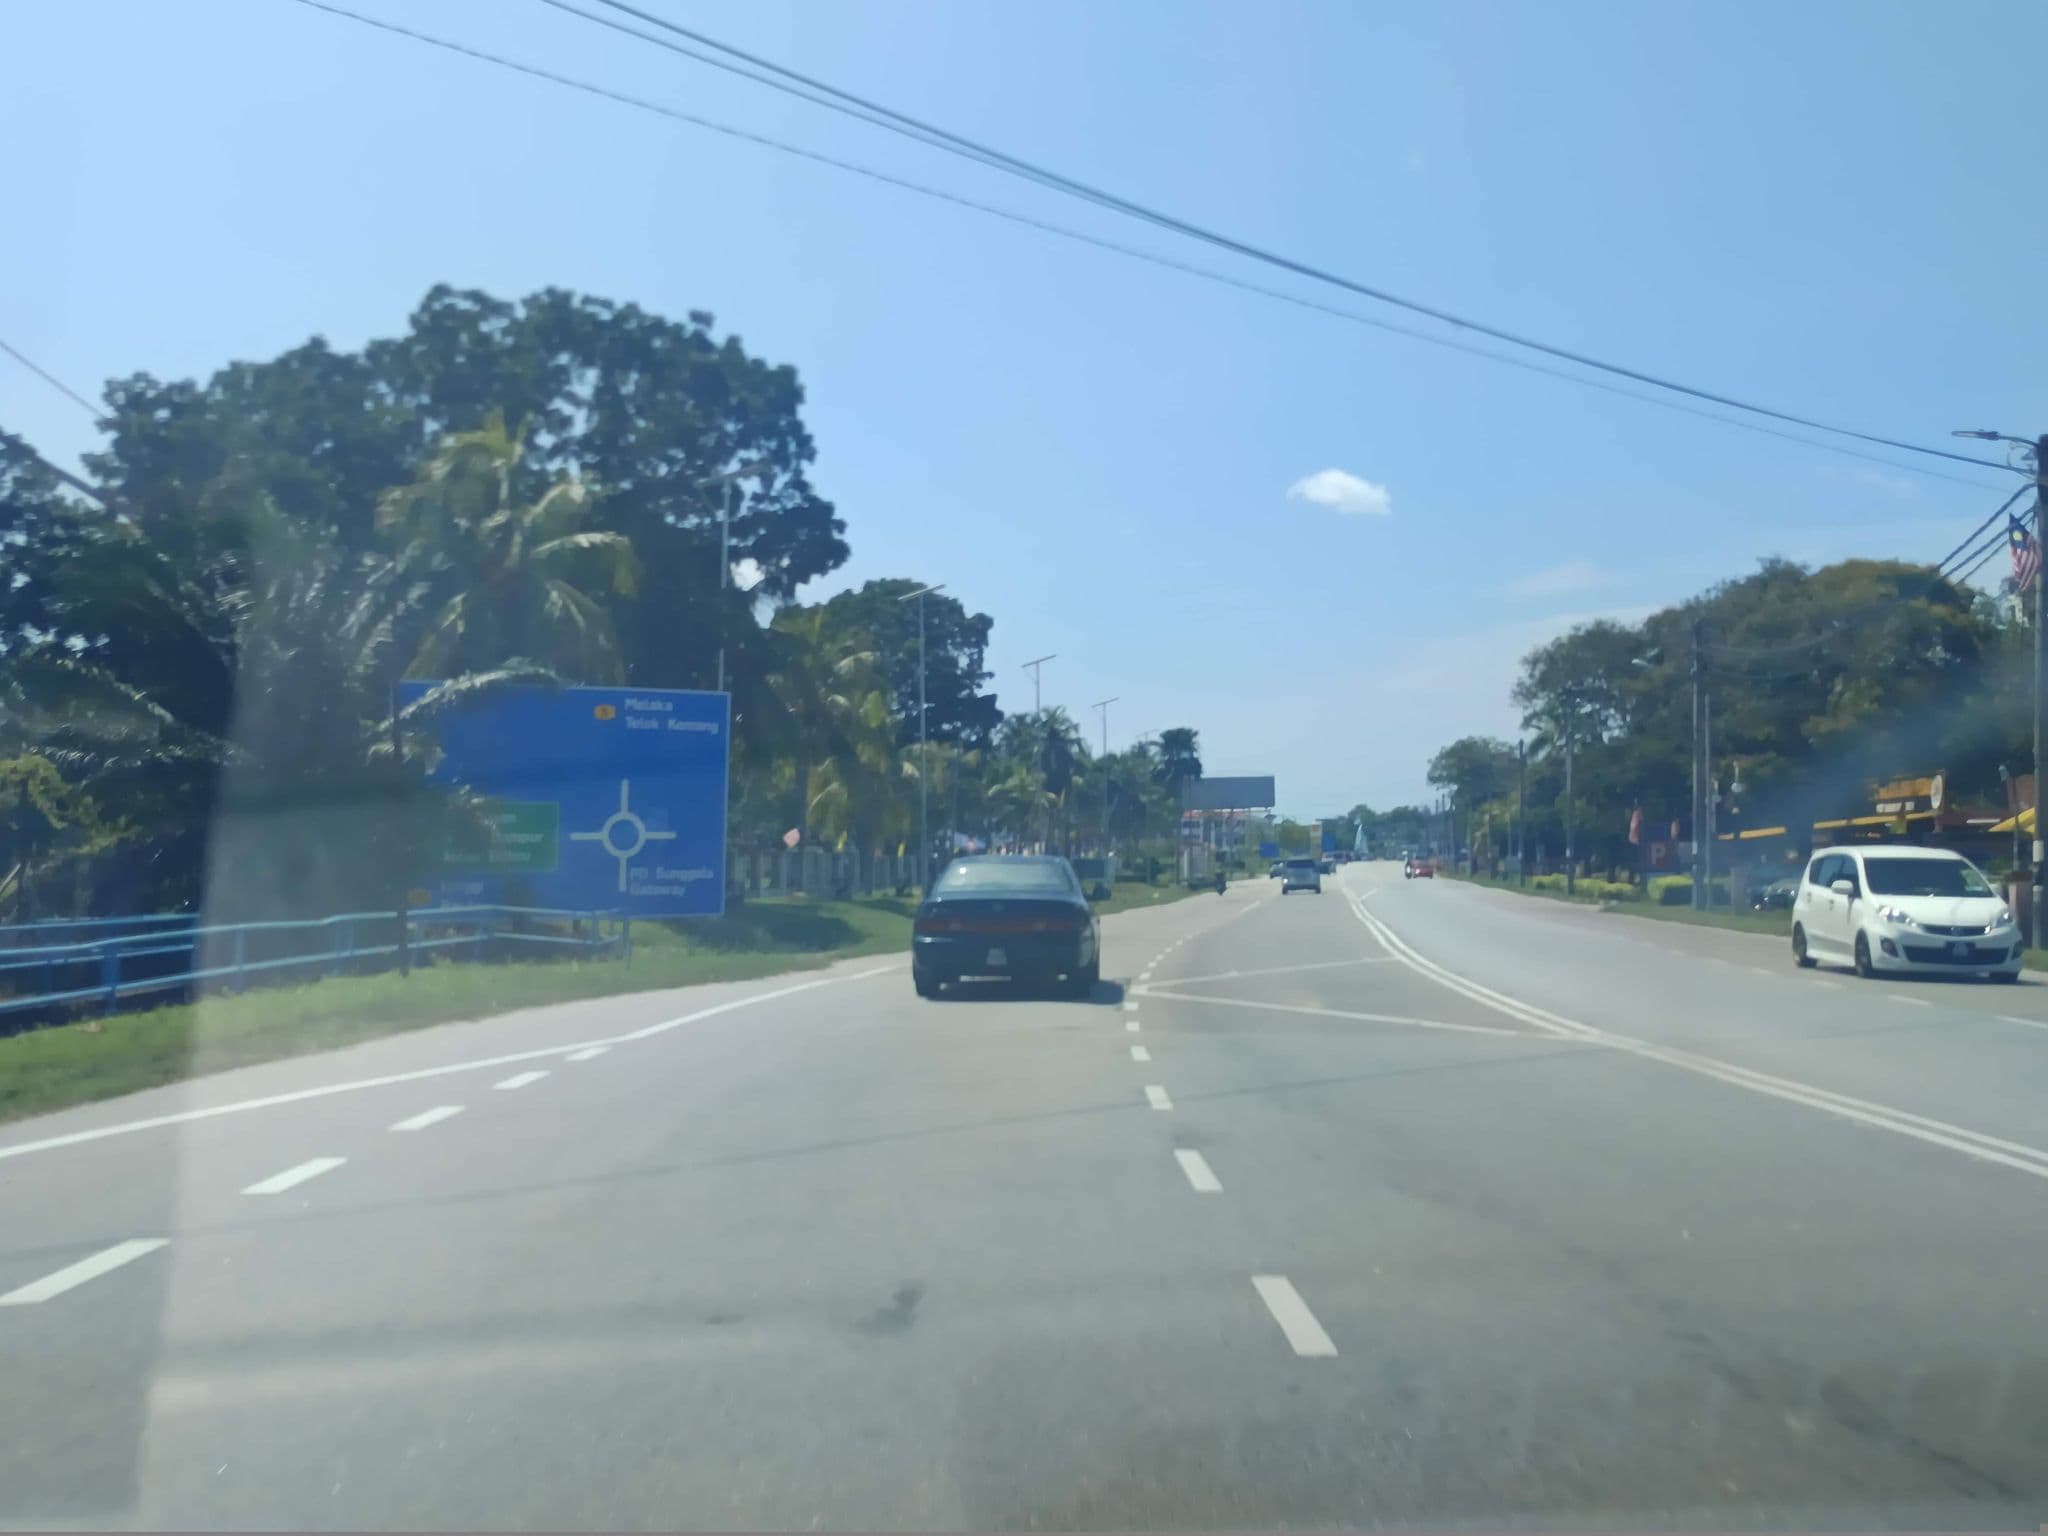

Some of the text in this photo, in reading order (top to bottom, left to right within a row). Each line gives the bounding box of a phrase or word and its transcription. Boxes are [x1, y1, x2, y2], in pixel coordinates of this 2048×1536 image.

[625, 698, 673, 711] Melaka
[625, 715, 719, 735] Telok Kemang
[1651, 843, 1666, 865] P
